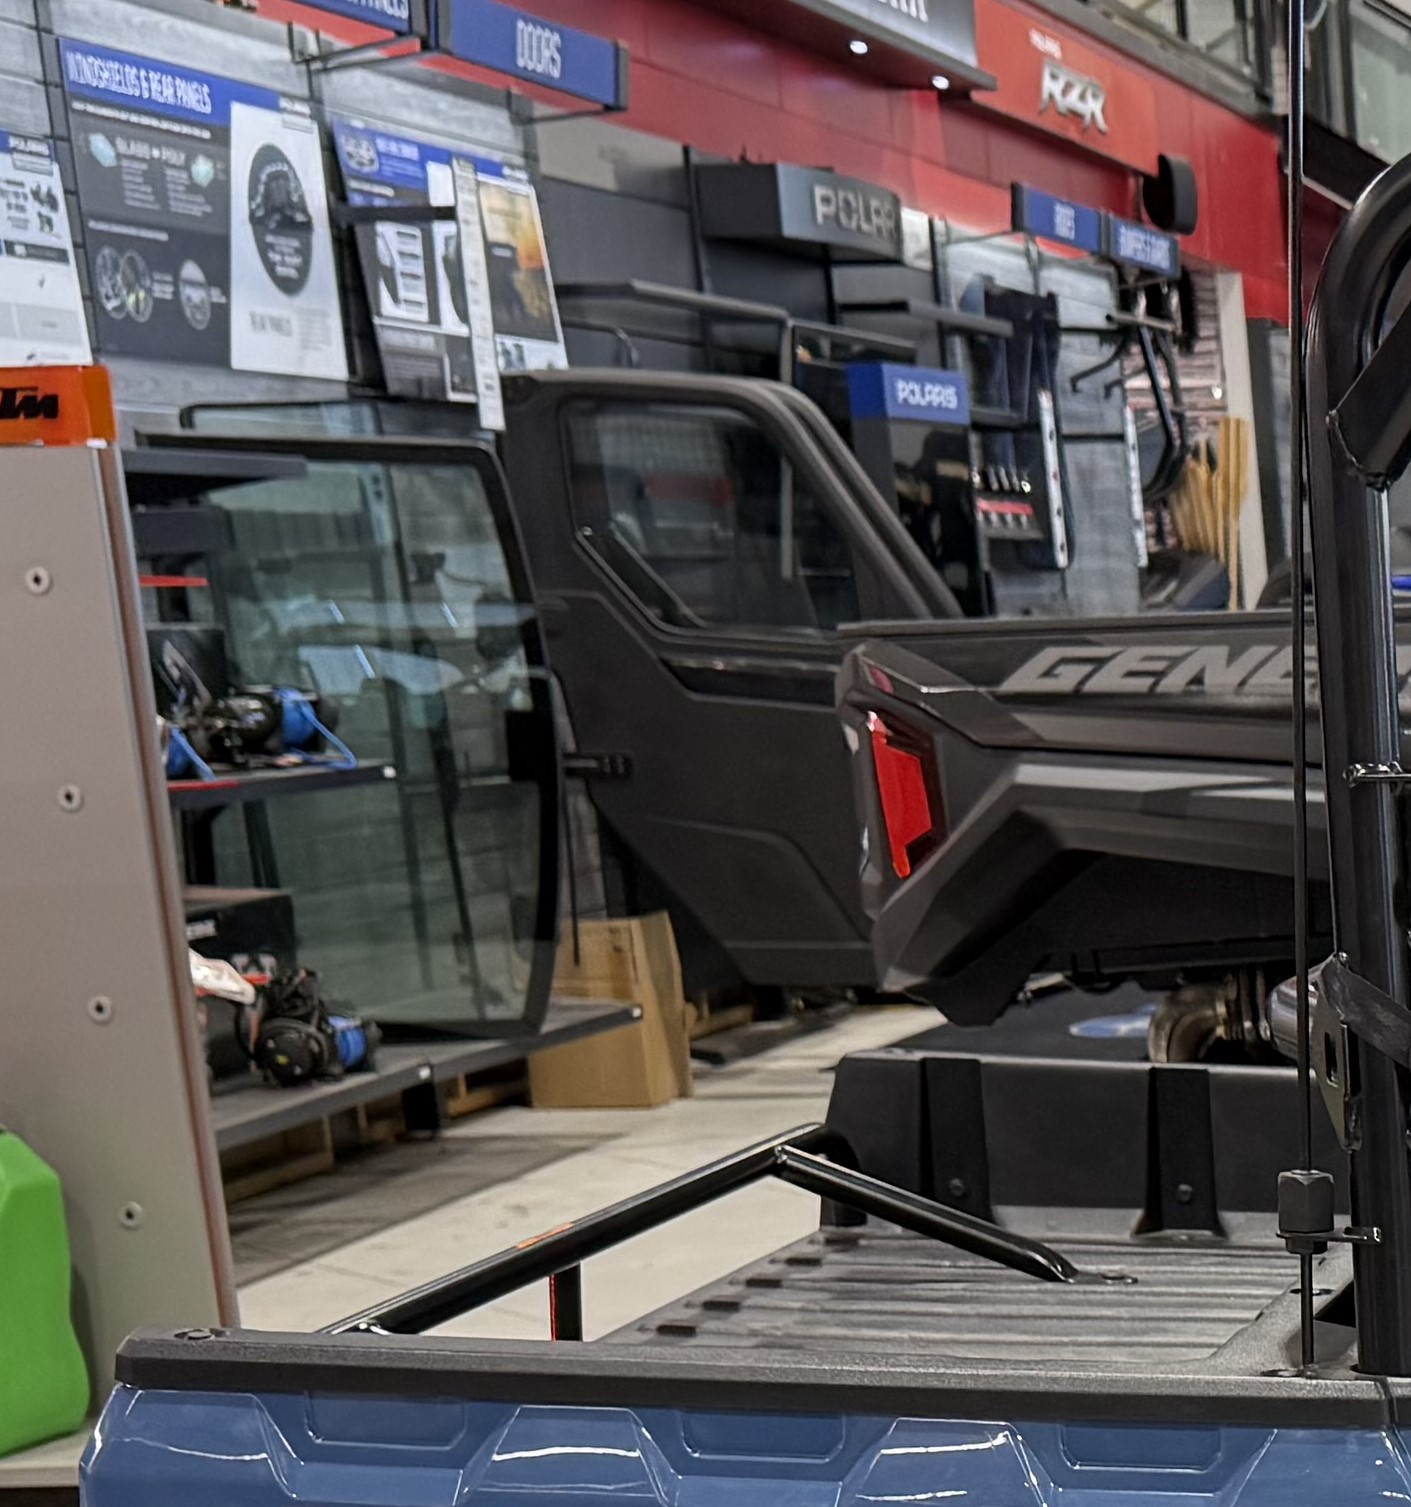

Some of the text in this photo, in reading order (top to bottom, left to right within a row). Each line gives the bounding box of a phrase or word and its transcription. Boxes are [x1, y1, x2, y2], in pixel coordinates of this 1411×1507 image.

[516, 19, 562, 79] DOORS
[0, 388, 59, 429] TM
[897, 380, 958, 410] POLARIS
